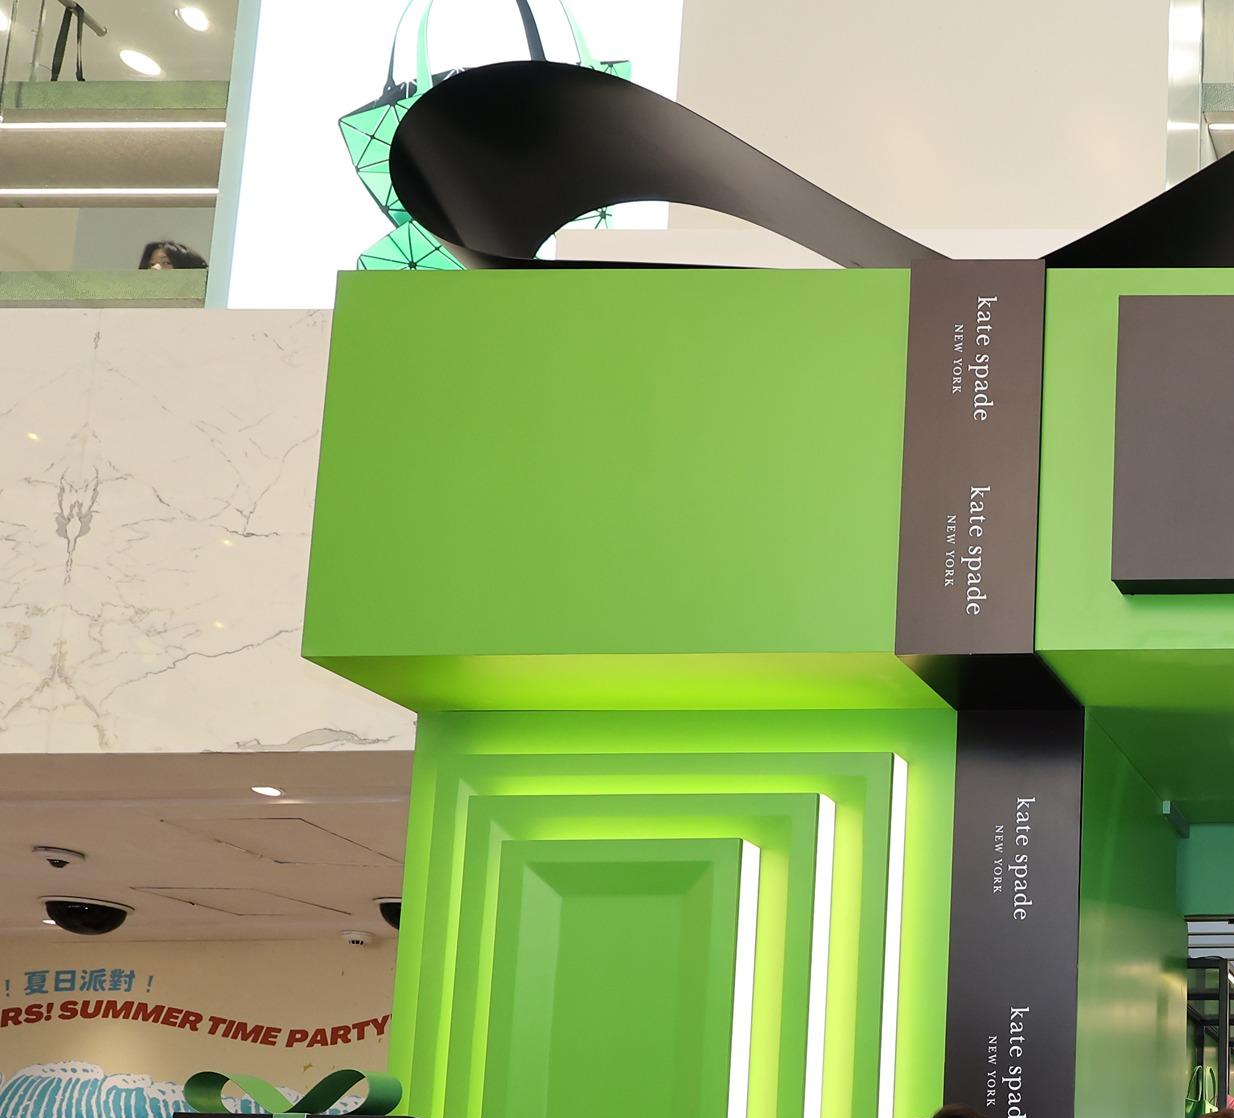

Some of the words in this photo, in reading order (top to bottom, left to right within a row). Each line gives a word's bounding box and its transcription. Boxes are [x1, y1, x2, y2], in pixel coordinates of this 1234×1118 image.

[953, 324, 964, 353] NEW
[975, 296, 998, 346] kate
[952, 358, 963, 394] YORK
[967, 354, 994, 421] spade
[946, 515, 957, 545] NEW
[968, 485, 991, 538] kate
[944, 550, 955, 587] YORK
[960, 545, 987, 615] spade
[994, 824, 1004, 854] NEW
[1015, 797, 1036, 846] kate
[993, 858, 1003, 893] YORK
[1007, 854, 1033, 920] spade
[58, 999, 203, 1032] SUMMER
[207, 1015, 282, 1047] TIME
[285, 1013, 392, 1048] PARTY
[1009, 1006, 1030, 1058] kate
[987, 1035, 998, 1065] NEW
[986, 1070, 997, 1107] YORK
